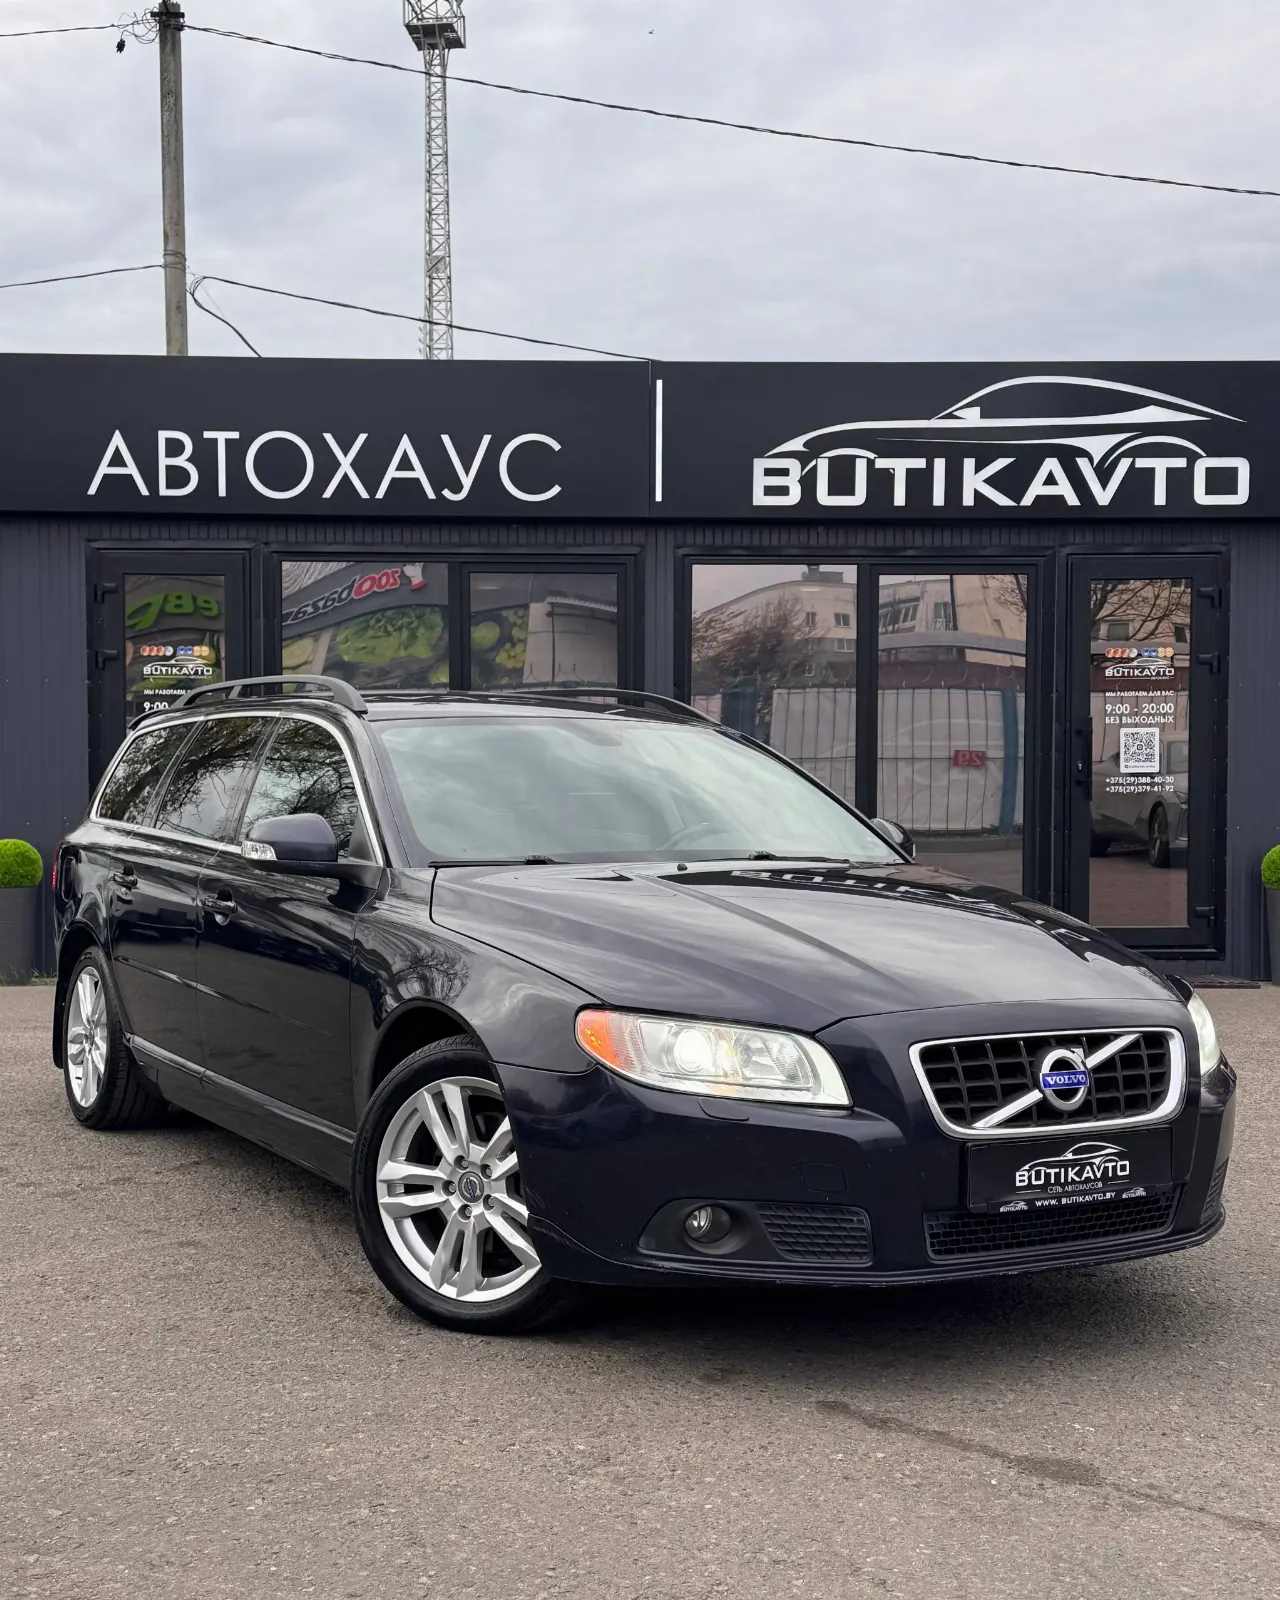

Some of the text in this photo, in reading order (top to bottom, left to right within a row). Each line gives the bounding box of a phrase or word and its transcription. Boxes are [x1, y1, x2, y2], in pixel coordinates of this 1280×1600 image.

[87, 429, 562, 502] АВТОХАУС
[752, 456, 1250, 507] BUTIKAVTO
[143, 666, 213, 675] BUTIKAVTO
[1105, 667, 1175, 677] BUTIKAVTO
[1105, 703, 1130, 714] 9:00
[1142, 703, 1174, 714] 20:00
[1105, 715, 1174, 724] БЕЗ ВЫХОДНЫХ
[1105, 776, 1175, 785] +375(29)388-40-30
[1105, 785, 1175, 794] +375(29)379-41-92
[1045, 1074, 1086, 1085] VOLVO
[1015, 1160, 1130, 1187] BUTIKAVTO
[1047, 1181, 1103, 1194] СЕТЬ АВТОХАУСОВ
[1061, 1191, 1116, 1205] BUTIKAVTO.BY
